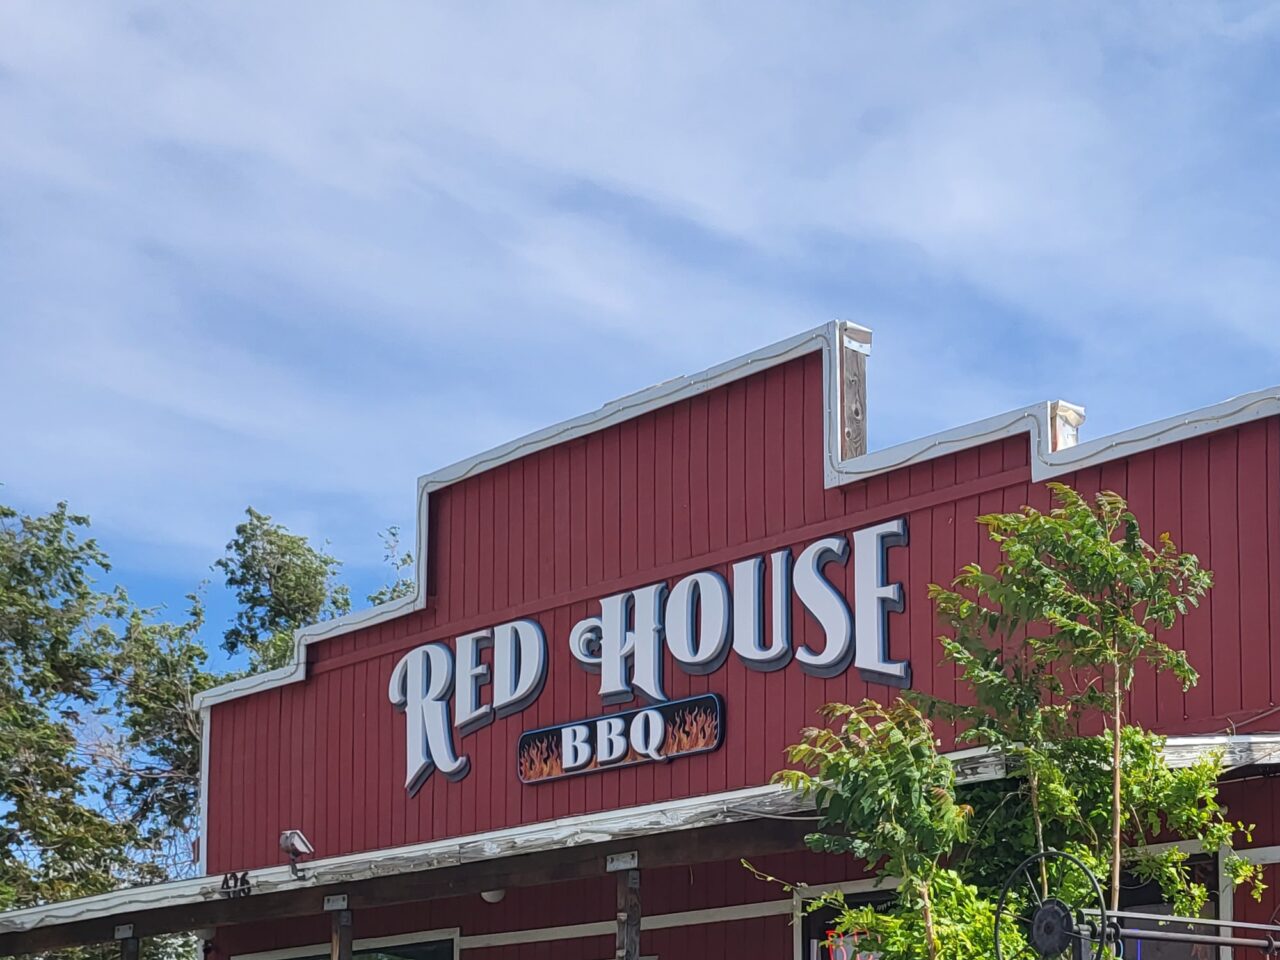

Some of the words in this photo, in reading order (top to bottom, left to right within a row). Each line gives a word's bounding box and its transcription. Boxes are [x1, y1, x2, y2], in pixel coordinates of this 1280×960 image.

[388, 618, 547, 793] RED
[568, 518, 911, 700] HOUSE
[561, 709, 671, 772] BBQ
